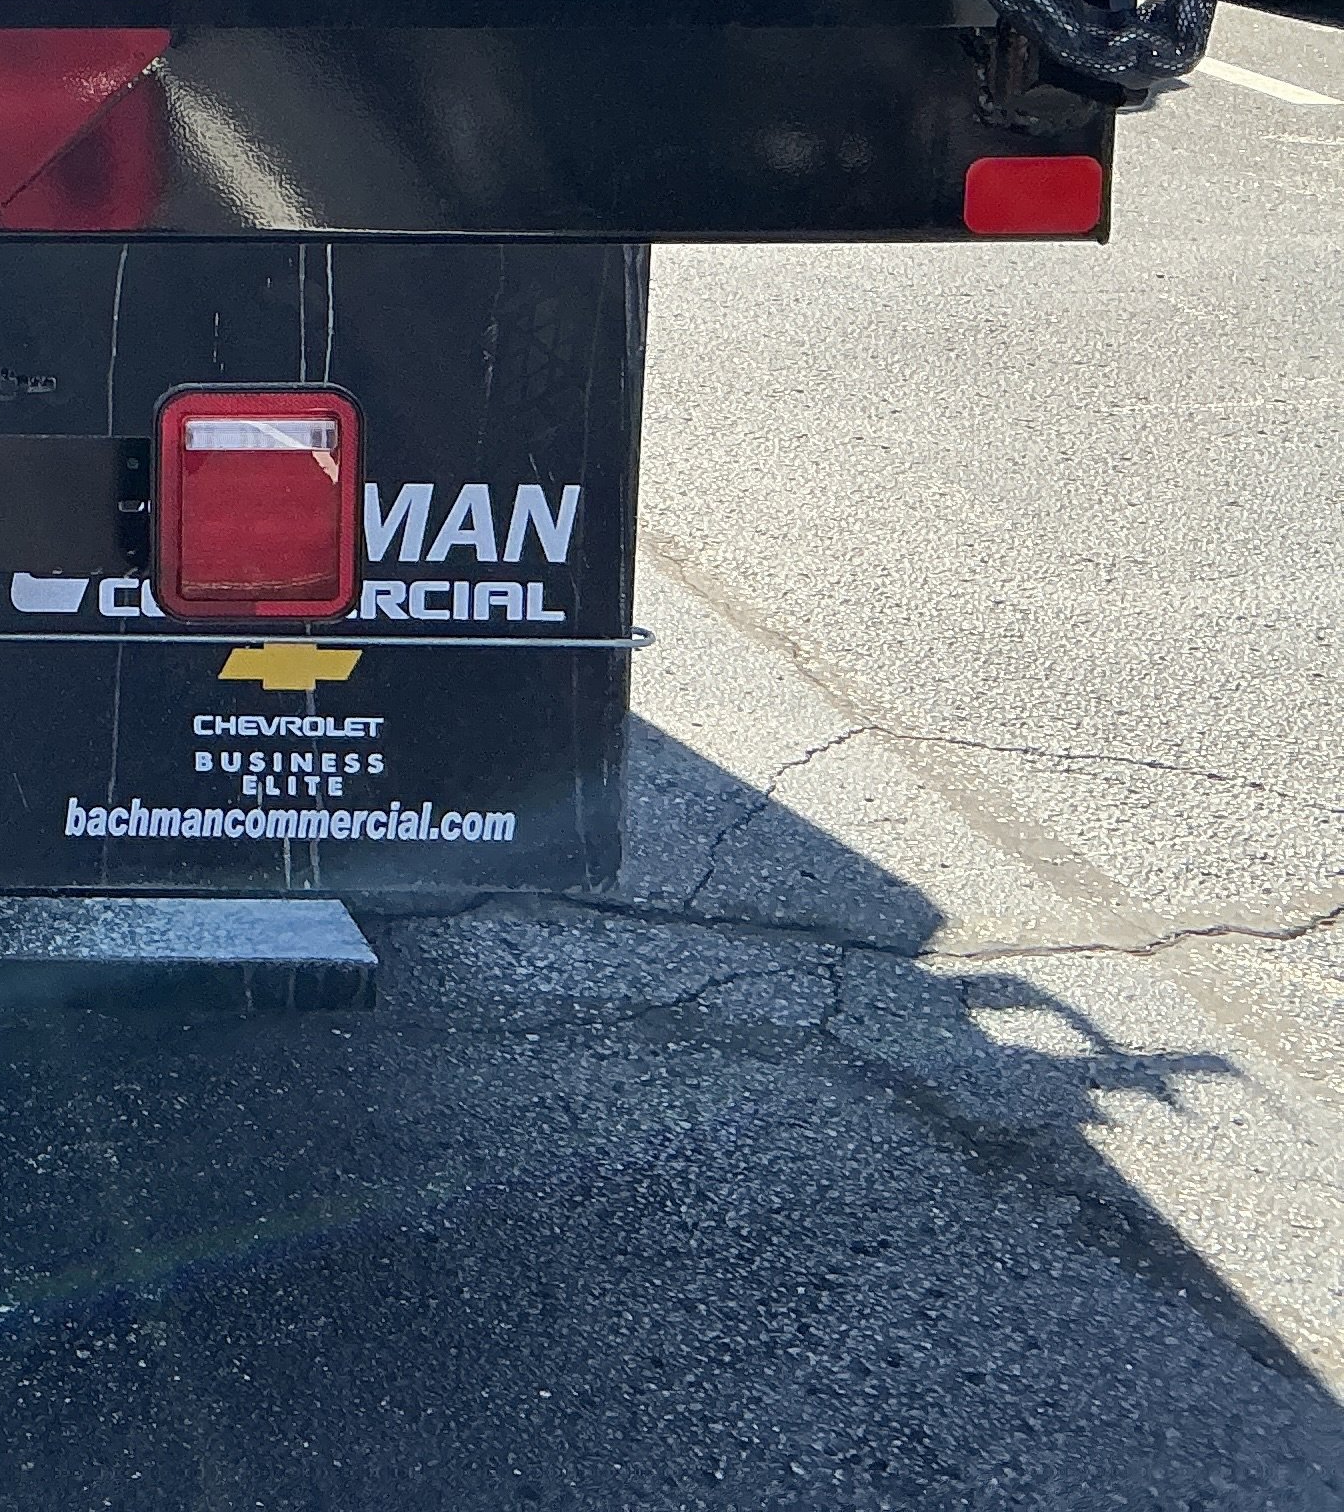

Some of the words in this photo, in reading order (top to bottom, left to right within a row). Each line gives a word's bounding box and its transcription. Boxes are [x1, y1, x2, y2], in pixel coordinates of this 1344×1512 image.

[98, 577, 567, 621] CRCIAL
[193, 714, 385, 738] CHEVROLET
[194, 751, 385, 774] BUSINESS
[242, 774, 344, 797] ELITE
[64, 798, 516, 841] bachmancommercial.com
